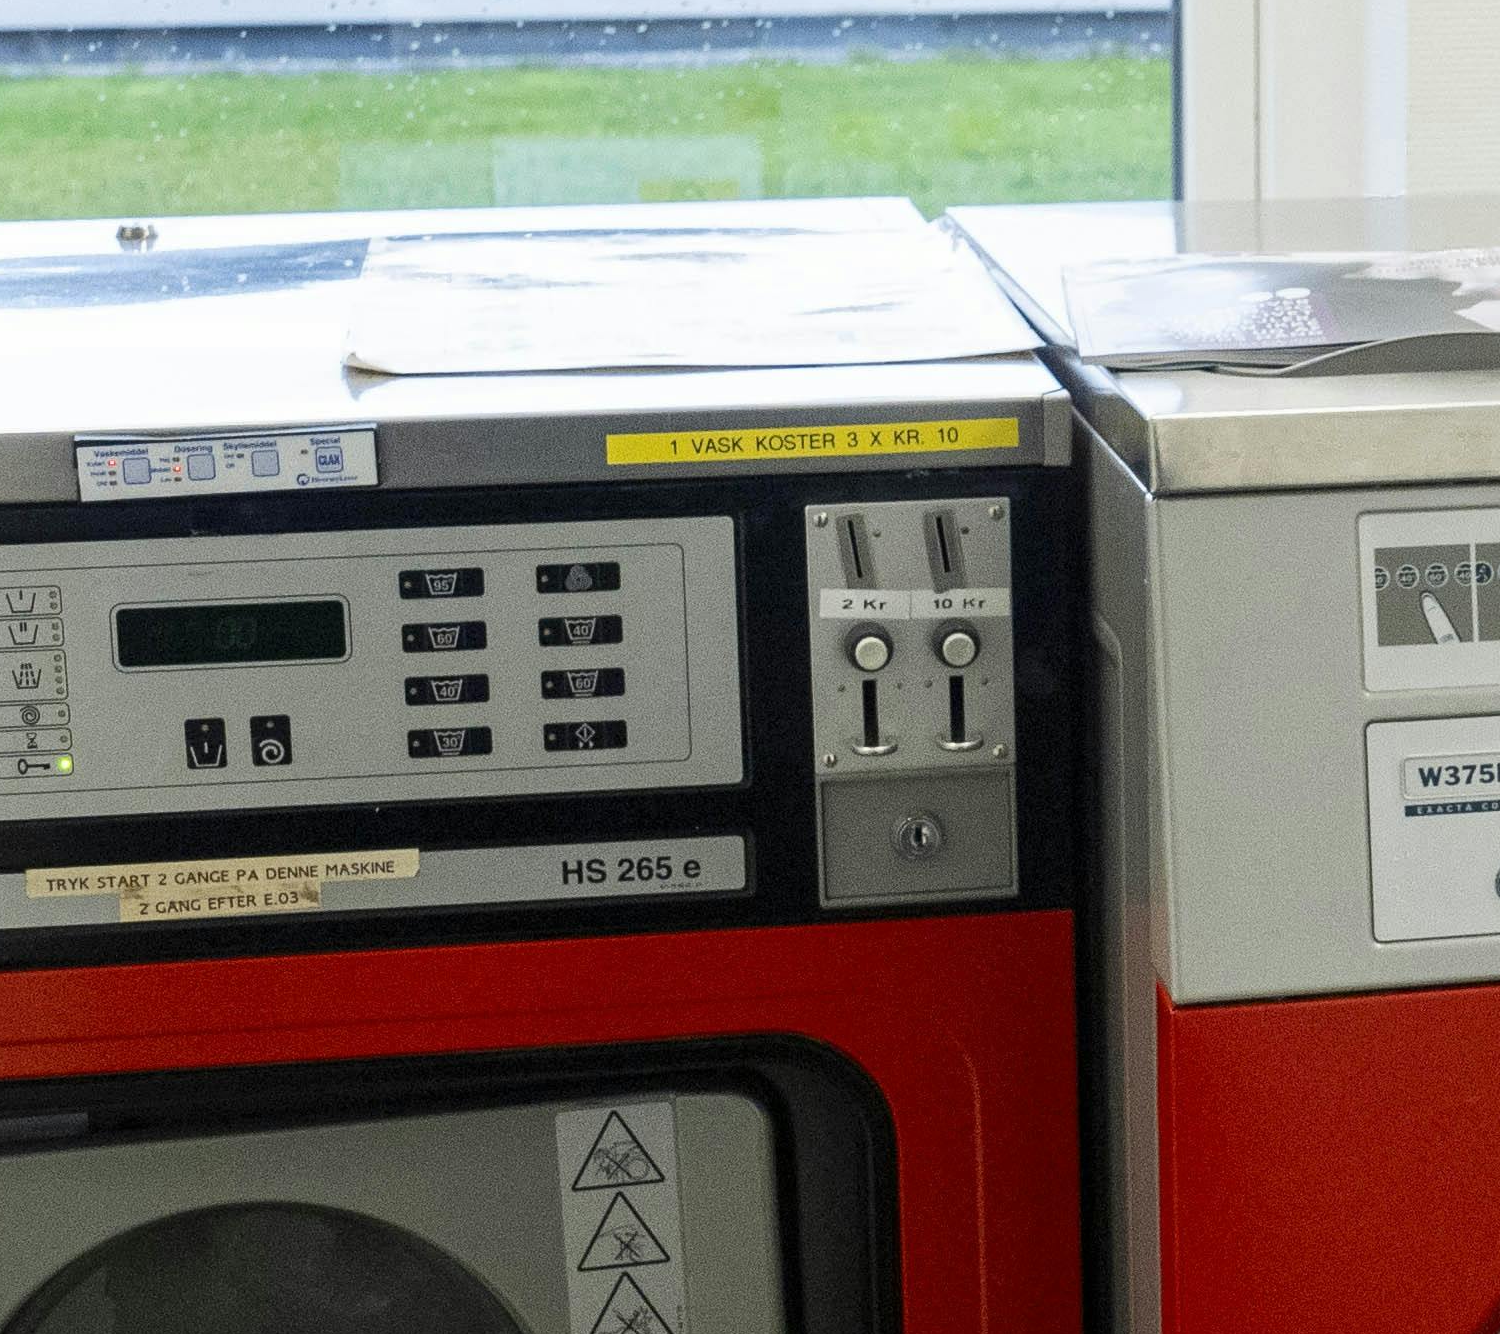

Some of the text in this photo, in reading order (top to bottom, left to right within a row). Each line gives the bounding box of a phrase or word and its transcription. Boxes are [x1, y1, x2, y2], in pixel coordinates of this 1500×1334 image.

[310, 437, 340, 446] Special
[670, 427, 959, 455] 1 VASK KOSTER 3 X KR. 10
[319, 455, 341, 465] CLAX
[842, 599, 887, 610] 2 Kr
[934, 597, 986, 609] 10 Kr
[1417, 804, 1472, 815] EXACTA
[46, 877, 90, 892] TRYK
[97, 874, 151, 889] START
[158, 873, 167, 886] 2
[174, 870, 229, 886] GANGE
[266, 865, 319, 880] DENNE
[325, 860, 395, 876] MASKINE
[562, 856, 701, 885] HS 265 e
[139, 891, 299, 915] 2 GANG EFTER E.03
